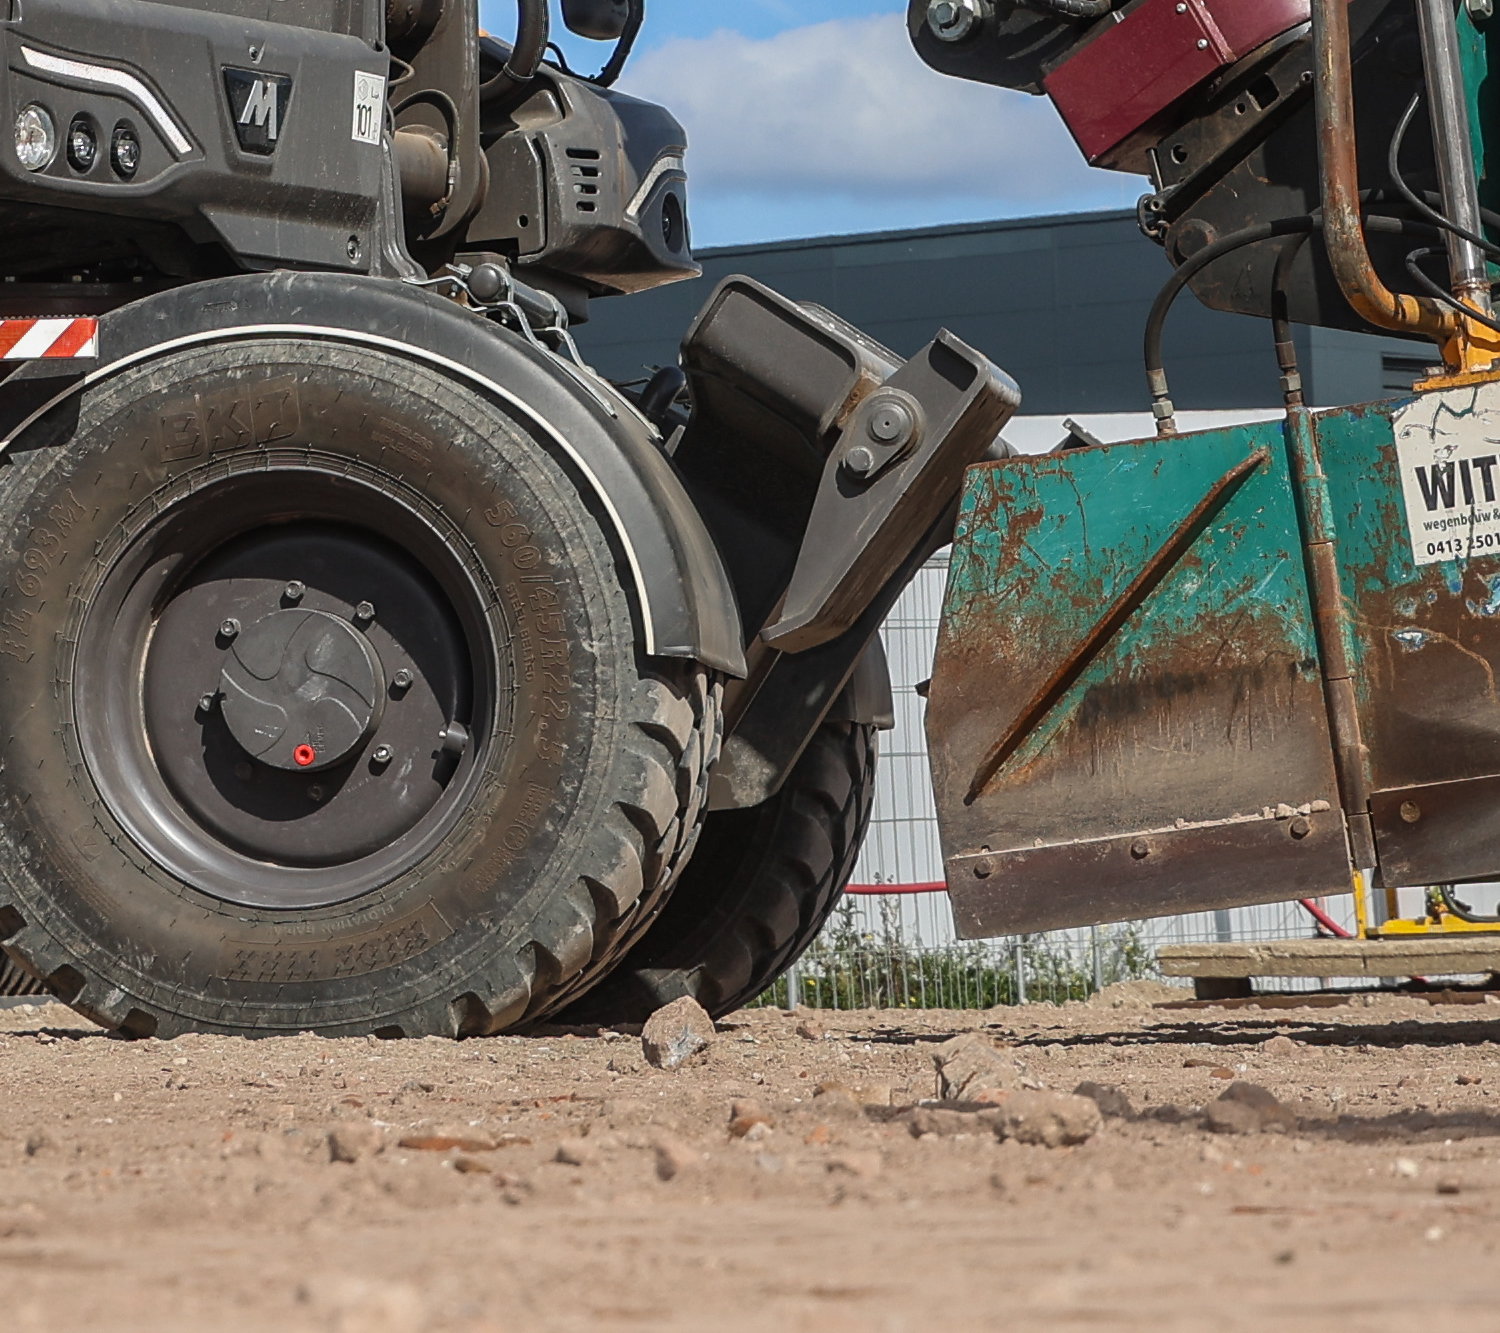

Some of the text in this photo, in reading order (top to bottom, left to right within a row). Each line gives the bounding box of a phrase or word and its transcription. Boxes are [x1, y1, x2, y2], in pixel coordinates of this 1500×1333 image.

[238, 79, 277, 140] M
[357, 103, 372, 138] 101
[1427, 538, 1463, 556] 0413
[505, 583, 525, 626] STEEL
